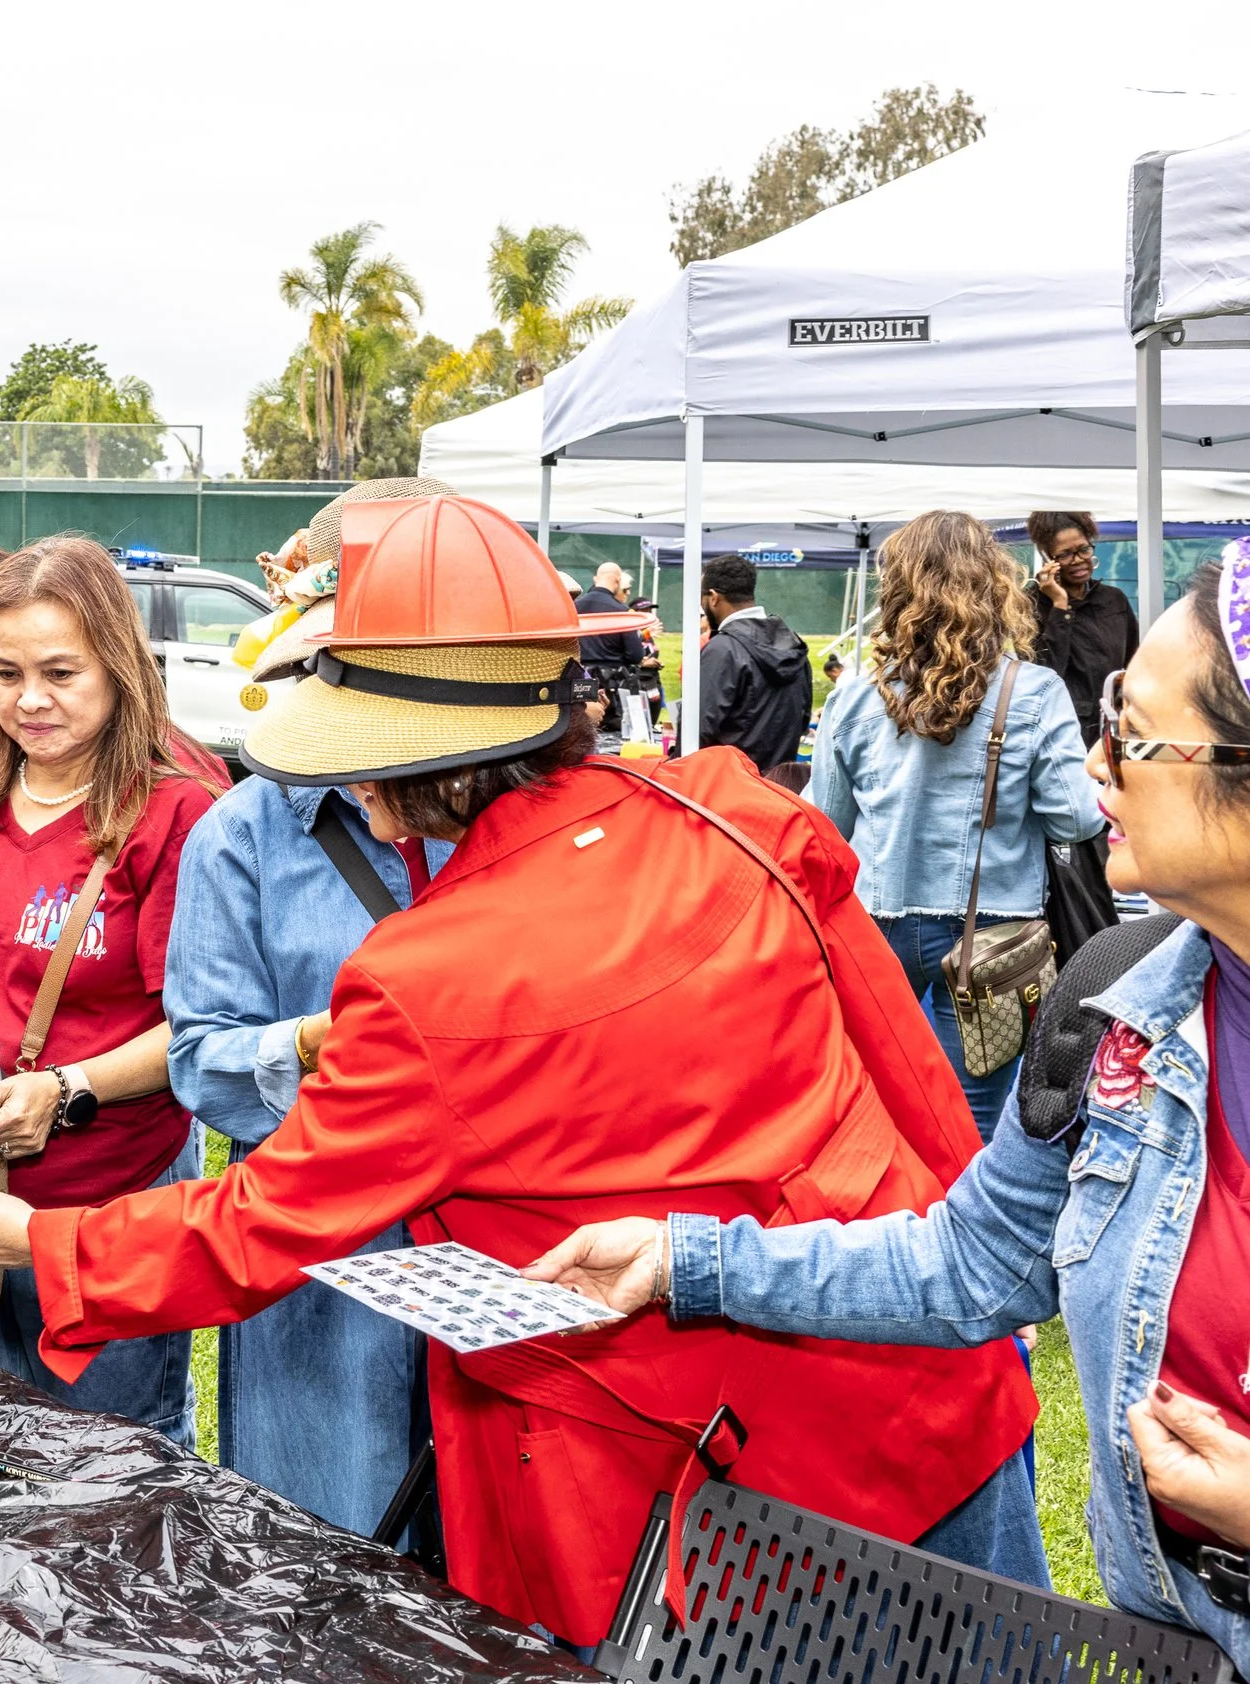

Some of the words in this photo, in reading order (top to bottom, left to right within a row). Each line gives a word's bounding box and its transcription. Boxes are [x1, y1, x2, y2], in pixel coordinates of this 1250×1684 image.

[794, 319, 925, 342] EVERBILT
[762, 553, 799, 562] DIEGO
[220, 737, 241, 746] AND
